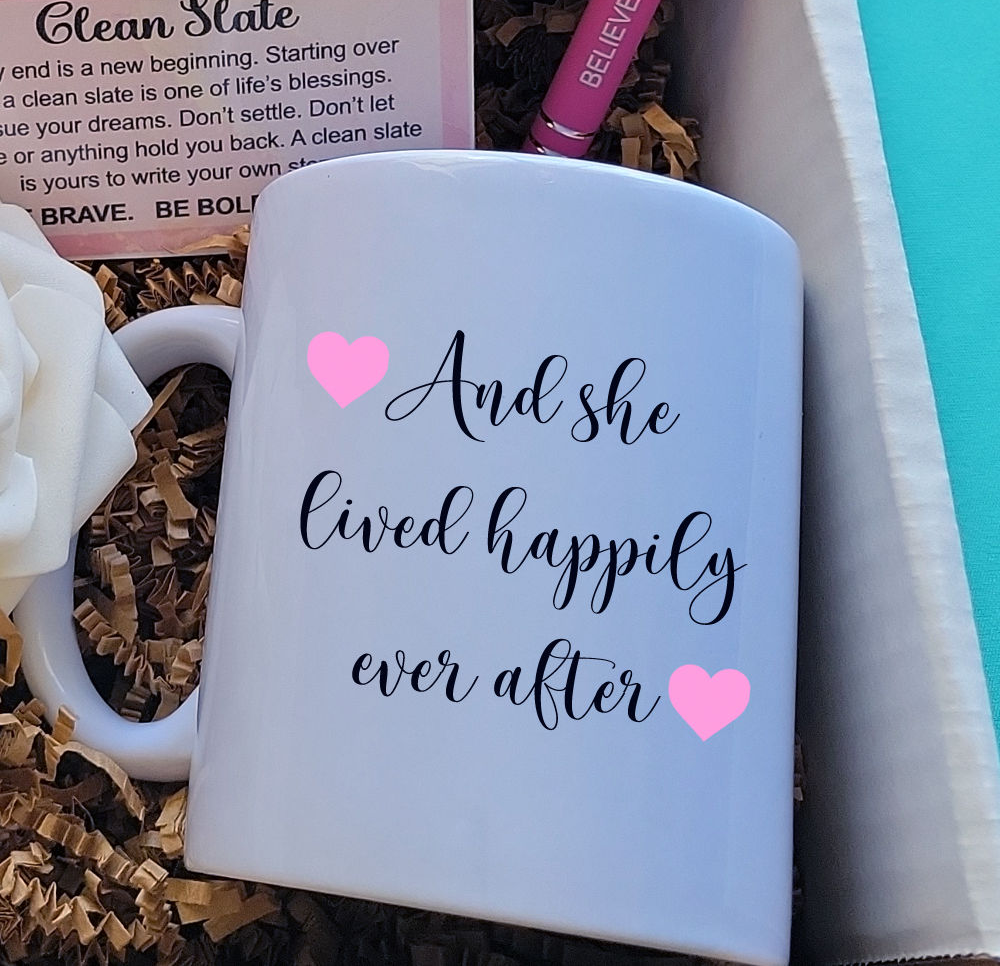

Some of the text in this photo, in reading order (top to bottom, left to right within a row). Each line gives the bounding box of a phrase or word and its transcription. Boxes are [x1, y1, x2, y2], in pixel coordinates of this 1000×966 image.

[36, 1, 174, 44] Clean
[11, 61, 50, 80] end
[57, 60, 73, 77] is
[80, 63, 94, 76] a
[101, 59, 143, 75] new
[150, 50, 258, 76] beginning.
[266, 42, 345, 64] Starting
[353, 39, 400, 56] over
[3, 95, 15, 108] a
[22, 90, 77, 108] clean
[84, 87, 133, 104] slate
[141, 84, 157, 101] is
[164, 84, 203, 101] one
[210, 78, 230, 97] of
[289, 69, 392, 91] blessings.
[36, 119, 82, 139] your
[88, 114, 172, 133] dreams.
[240, 102, 301, 123] settle.
[370, 94, 395, 112] let
[14, 150, 34, 164] or
[41, 143, 129, 165] anything
[136, 138, 178, 158] hold
[186, 140, 222, 159] you
[230, 132, 284, 152] back.
[291, 129, 307, 146] A
[312, 127, 366, 145] clean
[373, 121, 422, 140] slate
[20, 175, 36, 192] is
[43, 172, 100, 195] yours
[106, 170, 125, 187] to
[132, 167, 180, 185] write
[187, 165, 233, 186] your
[239, 162, 281, 178] own
[42, 204, 134, 225] BRAVE.
[155, 199, 190, 219] BE
[385, 330, 680, 444] And she
[300, 470, 748, 625] lived happily
[352, 639, 660, 730] ever after
